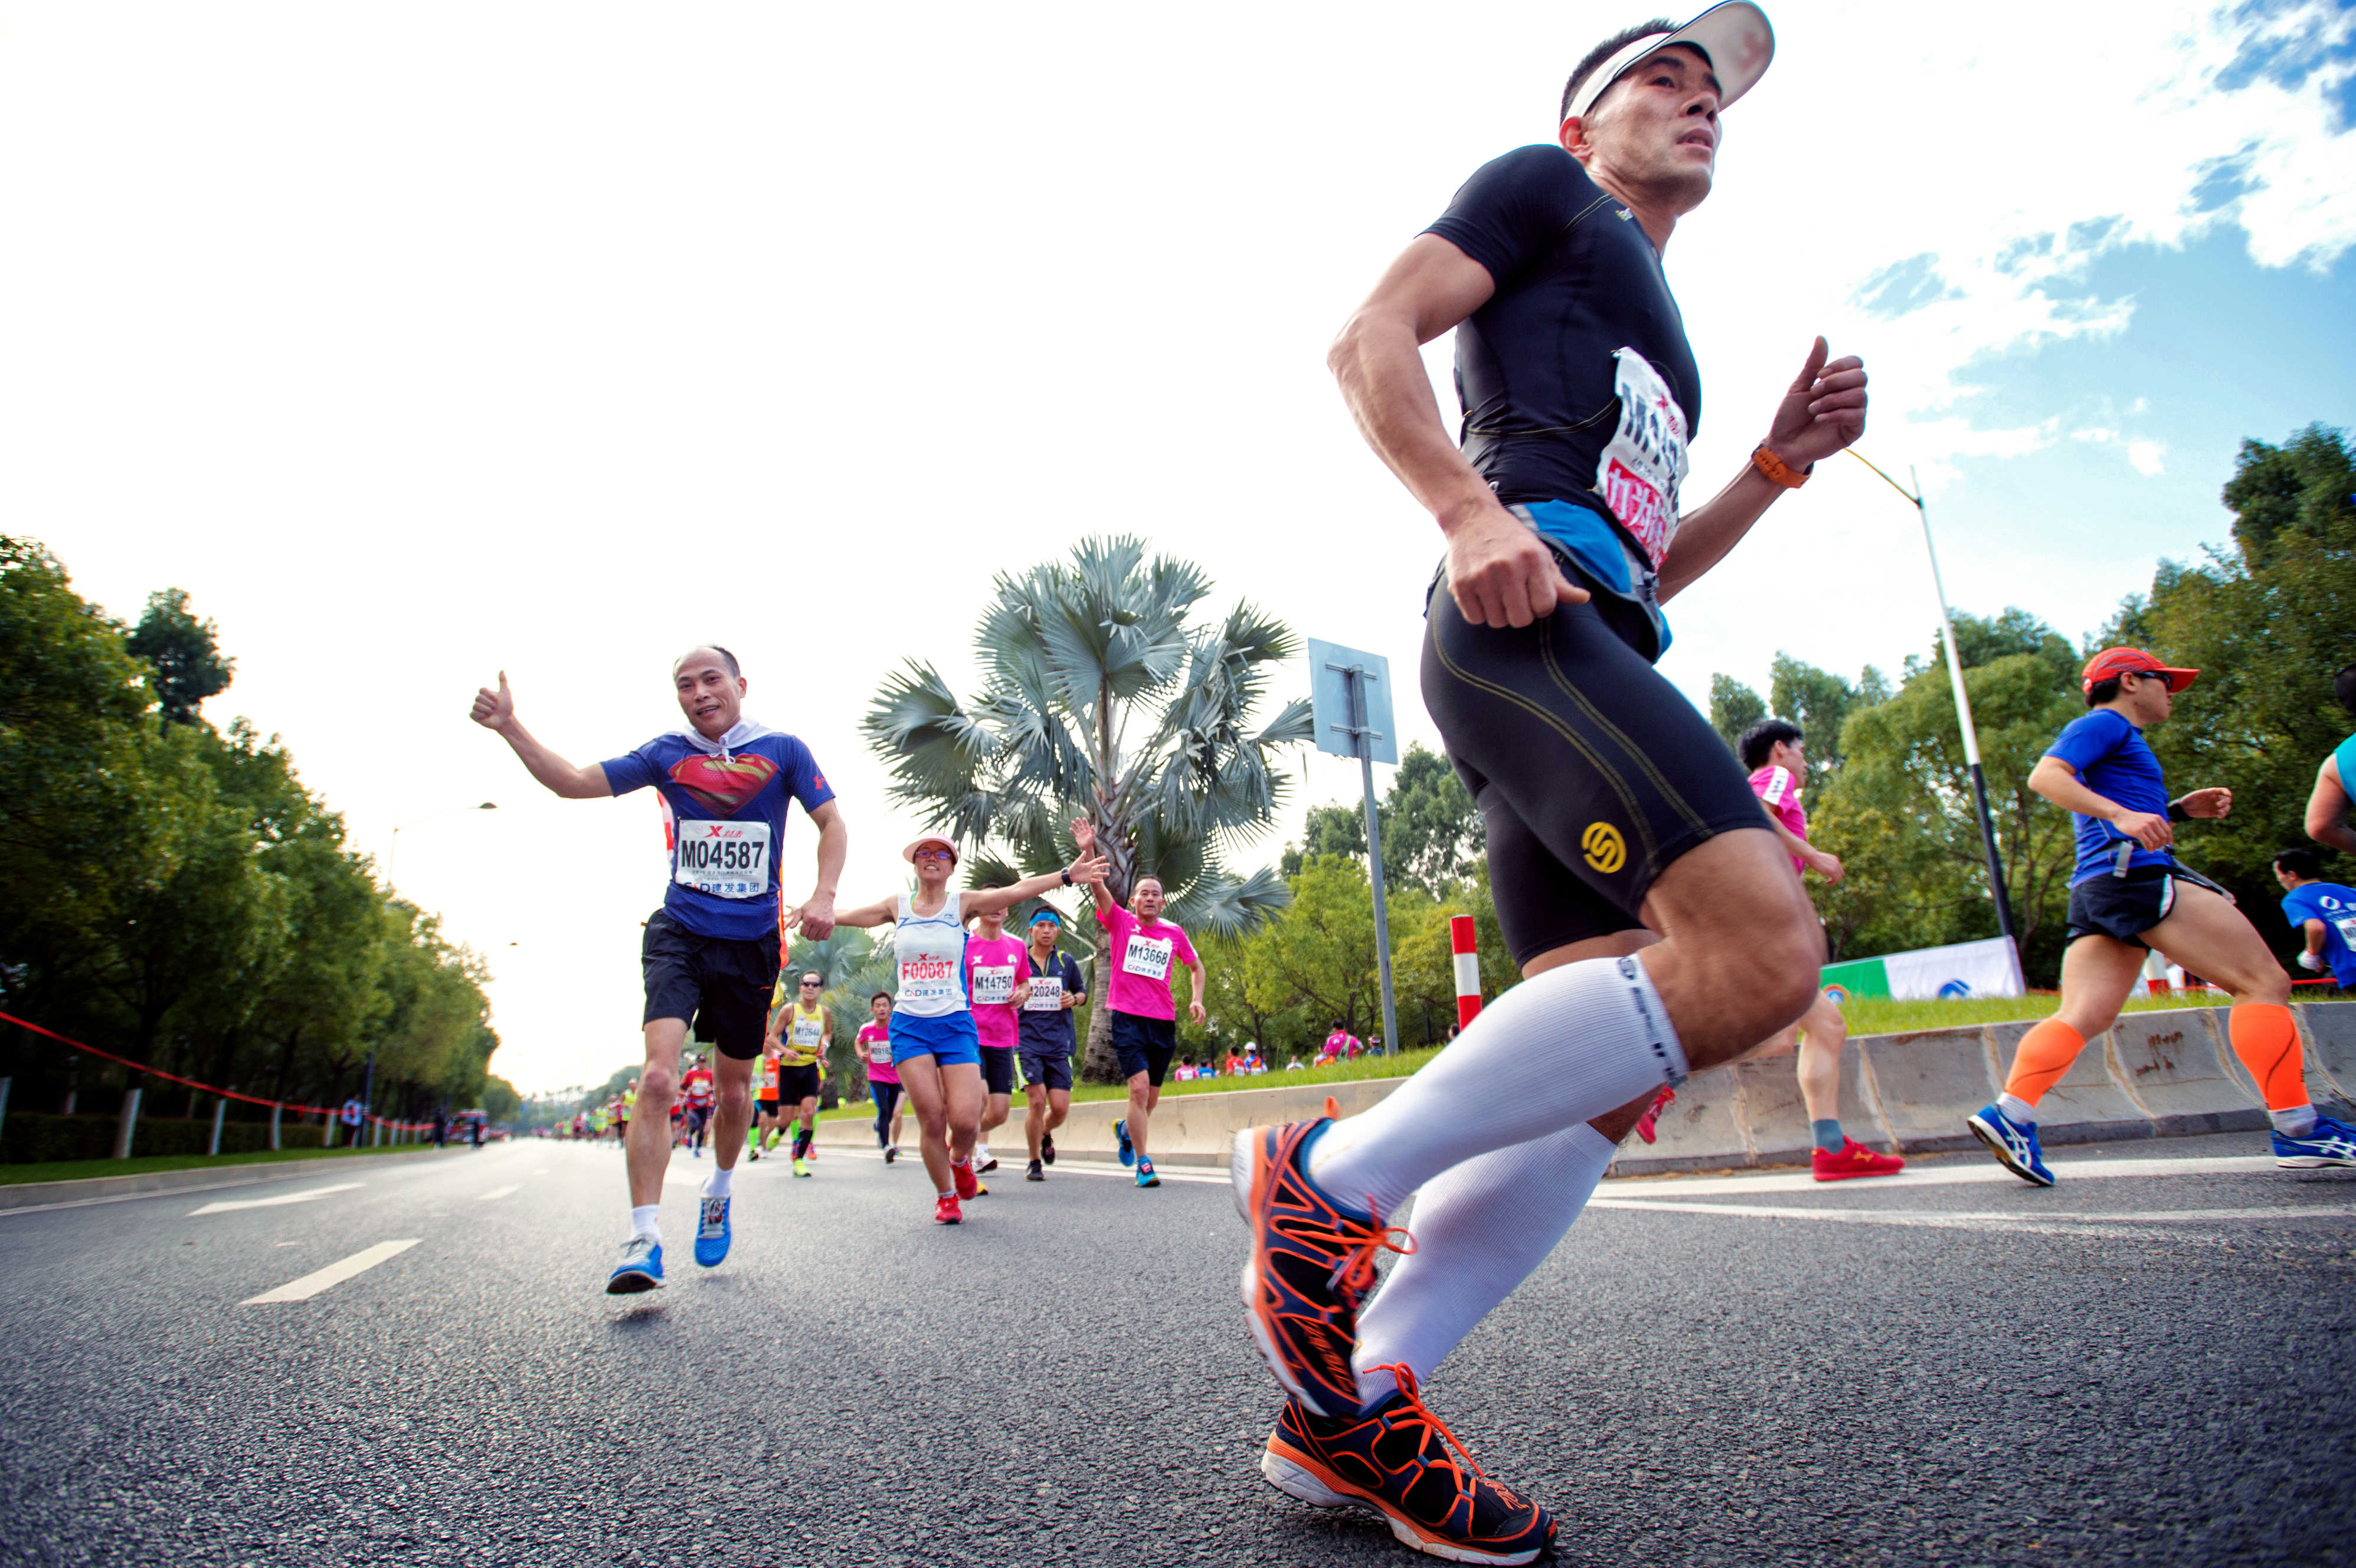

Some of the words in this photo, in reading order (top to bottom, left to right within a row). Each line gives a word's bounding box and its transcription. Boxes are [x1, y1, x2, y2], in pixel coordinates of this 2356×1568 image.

[681, 840, 764, 869] M04587
[1128, 944, 1169, 965] M13668
[902, 961, 953, 980] F00087
[975, 976, 1012, 990] M14750
